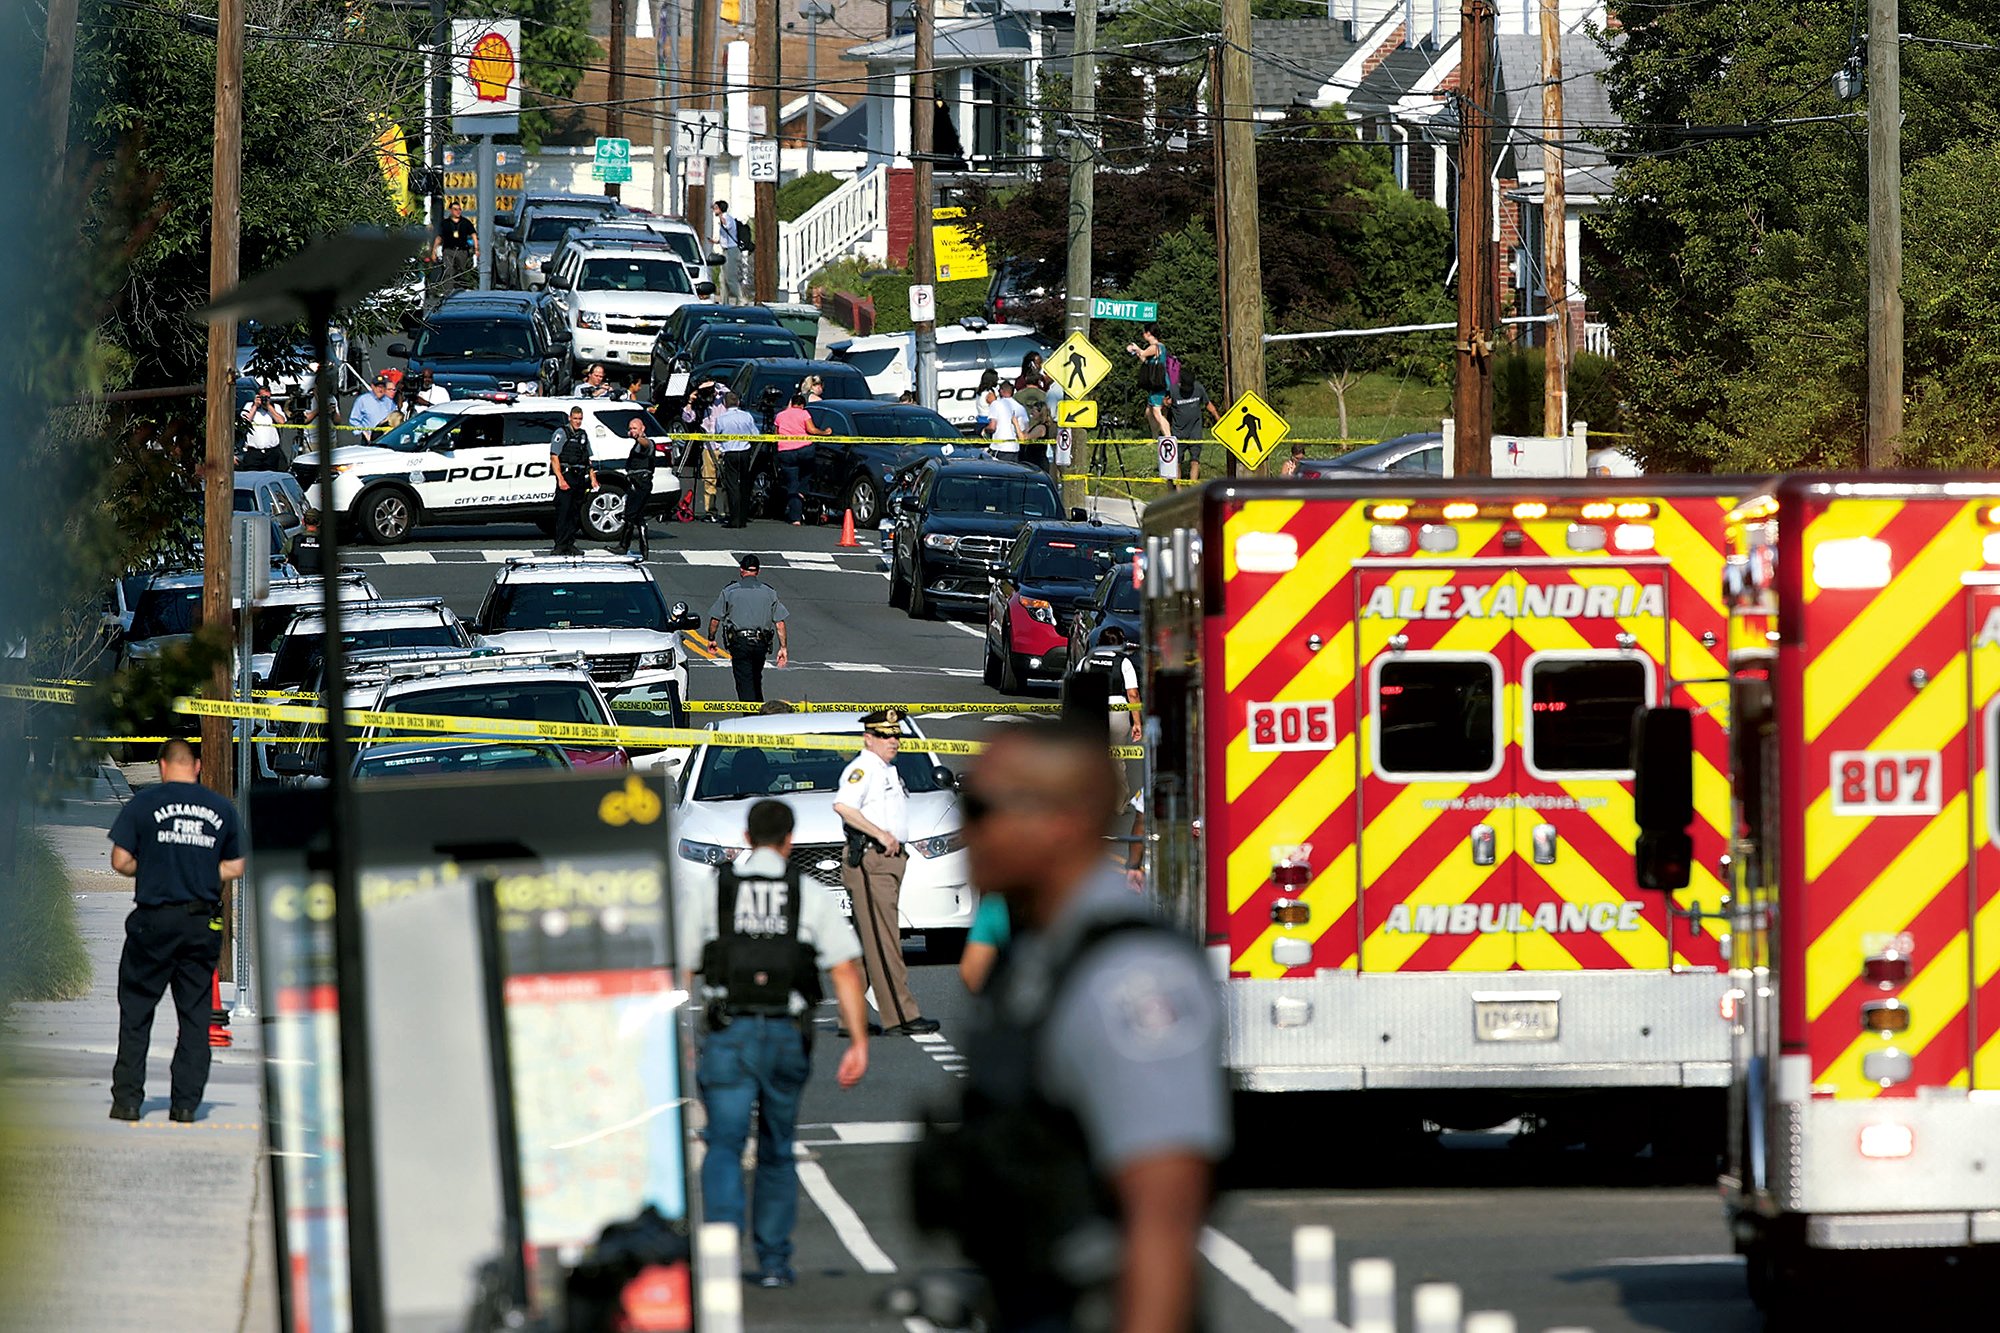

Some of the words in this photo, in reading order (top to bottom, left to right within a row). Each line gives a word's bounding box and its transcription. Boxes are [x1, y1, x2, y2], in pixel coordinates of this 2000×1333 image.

[751, 162, 775, 177] 25
[1096, 300, 1138, 318] DEWITT
[447, 462, 556, 483] POLIC
[454, 497, 478, 505] CITY
[499, 492, 556, 503] ALEXANDR
[1362, 584, 1666, 619] ALEXANDRIA
[233, 705, 251, 717] SCENE
[252, 706, 272, 718] CRIME
[620, 702, 641, 710] SCENE
[642, 702, 653, 710] DO
[703, 702, 726, 711] CRIME
[726, 703, 749, 711] SCENE
[750, 703, 760, 711] DO
[812, 704, 834, 712] CRIME
[834, 704, 857, 712] SCENE
[858, 704, 869, 712] DO
[869, 704, 884, 712] NOT
[920, 704, 944, 713] CRIME
[944, 704, 968, 713] SCENE
[968, 704, 978, 713] DO
[978, 704, 992, 713] NOT
[993, 704, 1019, 713] CROSS
[1029, 704, 1052, 713] CRIME
[153, 803, 224, 831] ALEXANDRIA
[173, 818, 204, 834] FIRE
[157, 830, 217, 849] DEPARTMENT
[735, 880, 789, 916] ATF
[734, 915, 789, 935] POLICE
[1384, 900, 1646, 935] AMBULANCE
